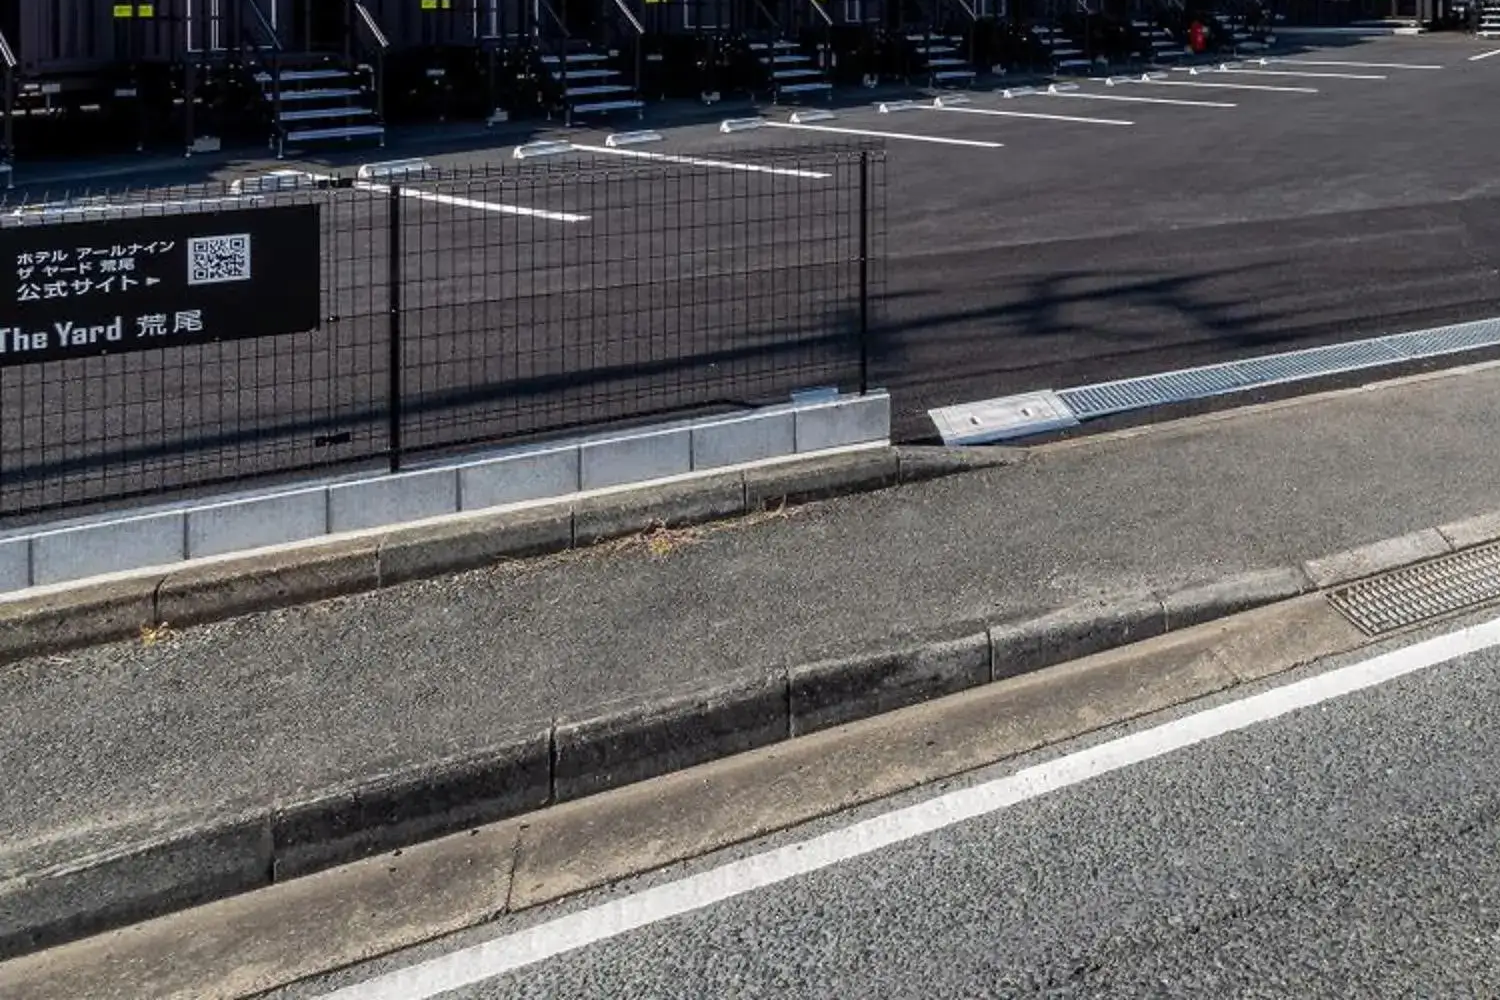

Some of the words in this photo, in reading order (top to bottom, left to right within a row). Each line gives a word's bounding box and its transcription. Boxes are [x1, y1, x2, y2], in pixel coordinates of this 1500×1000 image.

[17, 250, 69, 266] ホテル
[76, 241, 175, 260] アールナイン
[17, 265, 34, 280] ザ
[42, 261, 93, 278] ヤード
[100, 257, 135, 273] 荒尾
[17, 275, 139, 301] 公式サイト
[0, 327, 48, 352] The
[54, 316, 123, 347] Yard
[137, 309, 203, 338] 荒尾
